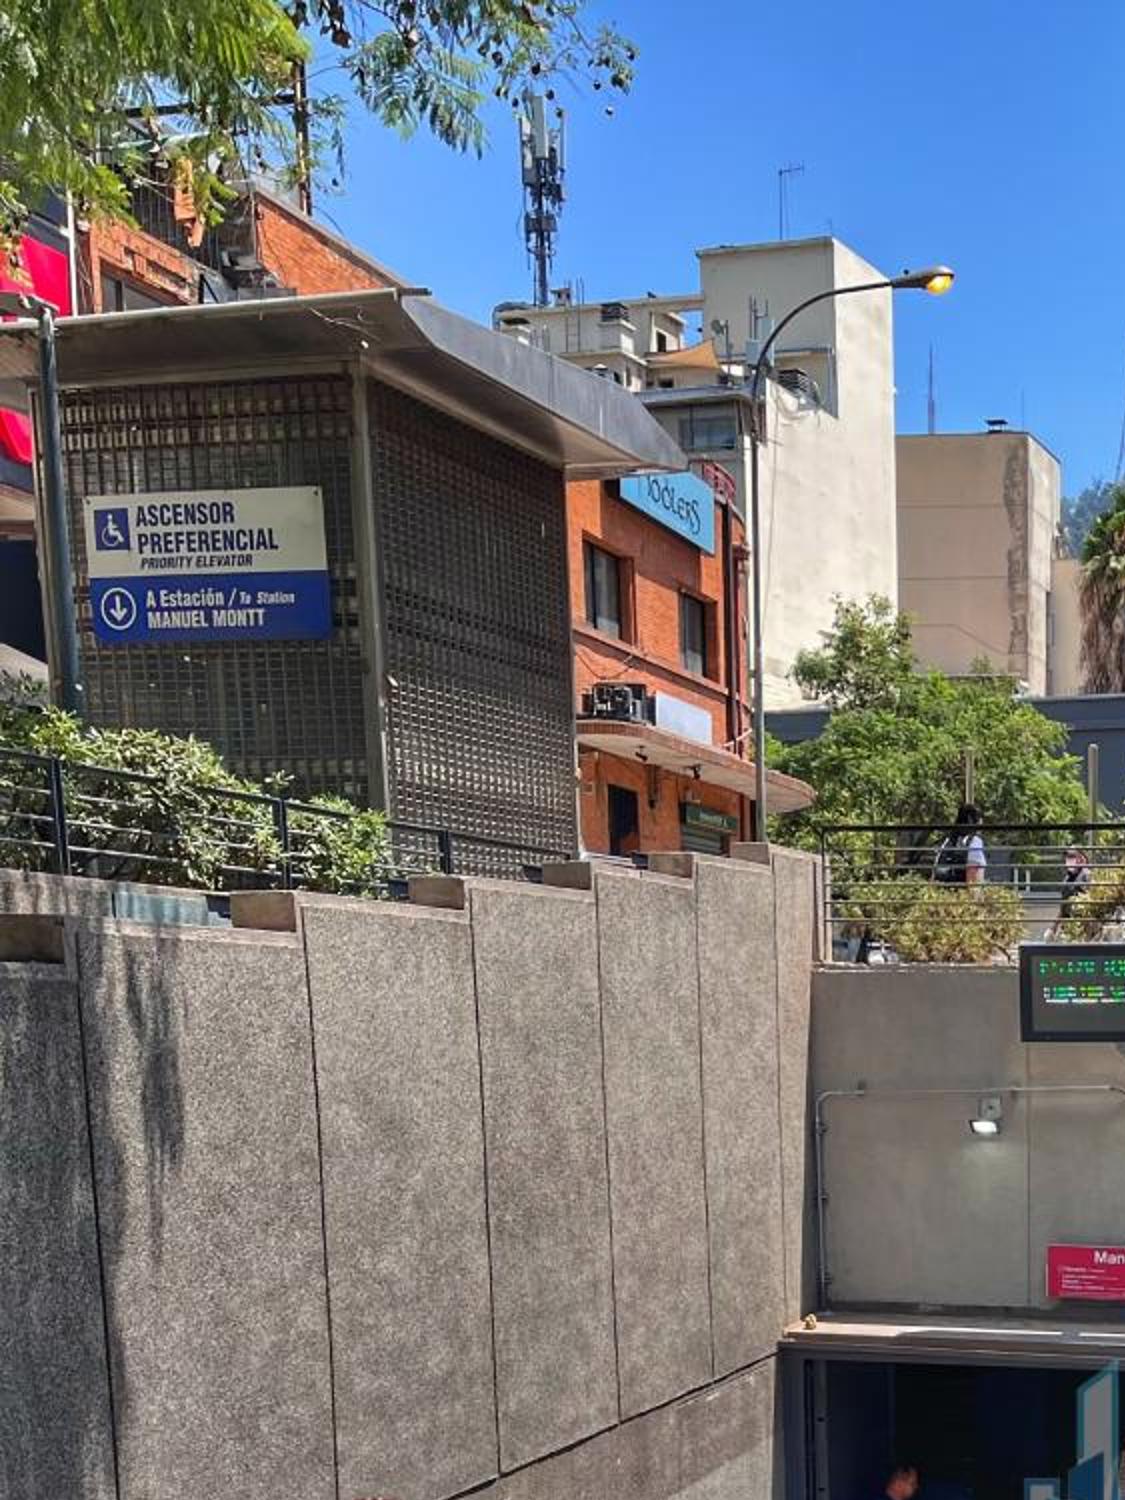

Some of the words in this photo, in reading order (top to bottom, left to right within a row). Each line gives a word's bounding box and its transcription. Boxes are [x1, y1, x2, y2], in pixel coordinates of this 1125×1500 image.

[136, 502, 235, 527] ASCENSOR
[138, 528, 279, 554] PREFERENCIAL
[140, 555, 192, 569] PRIORITY
[195, 553, 253, 568] ELEVATOR
[146, 590, 157, 608] A
[160, 588, 224, 607] Estación
[257, 591, 295, 604] Station
[147, 610, 209, 629] MANUEL
[213, 608, 264, 627] MONTT
